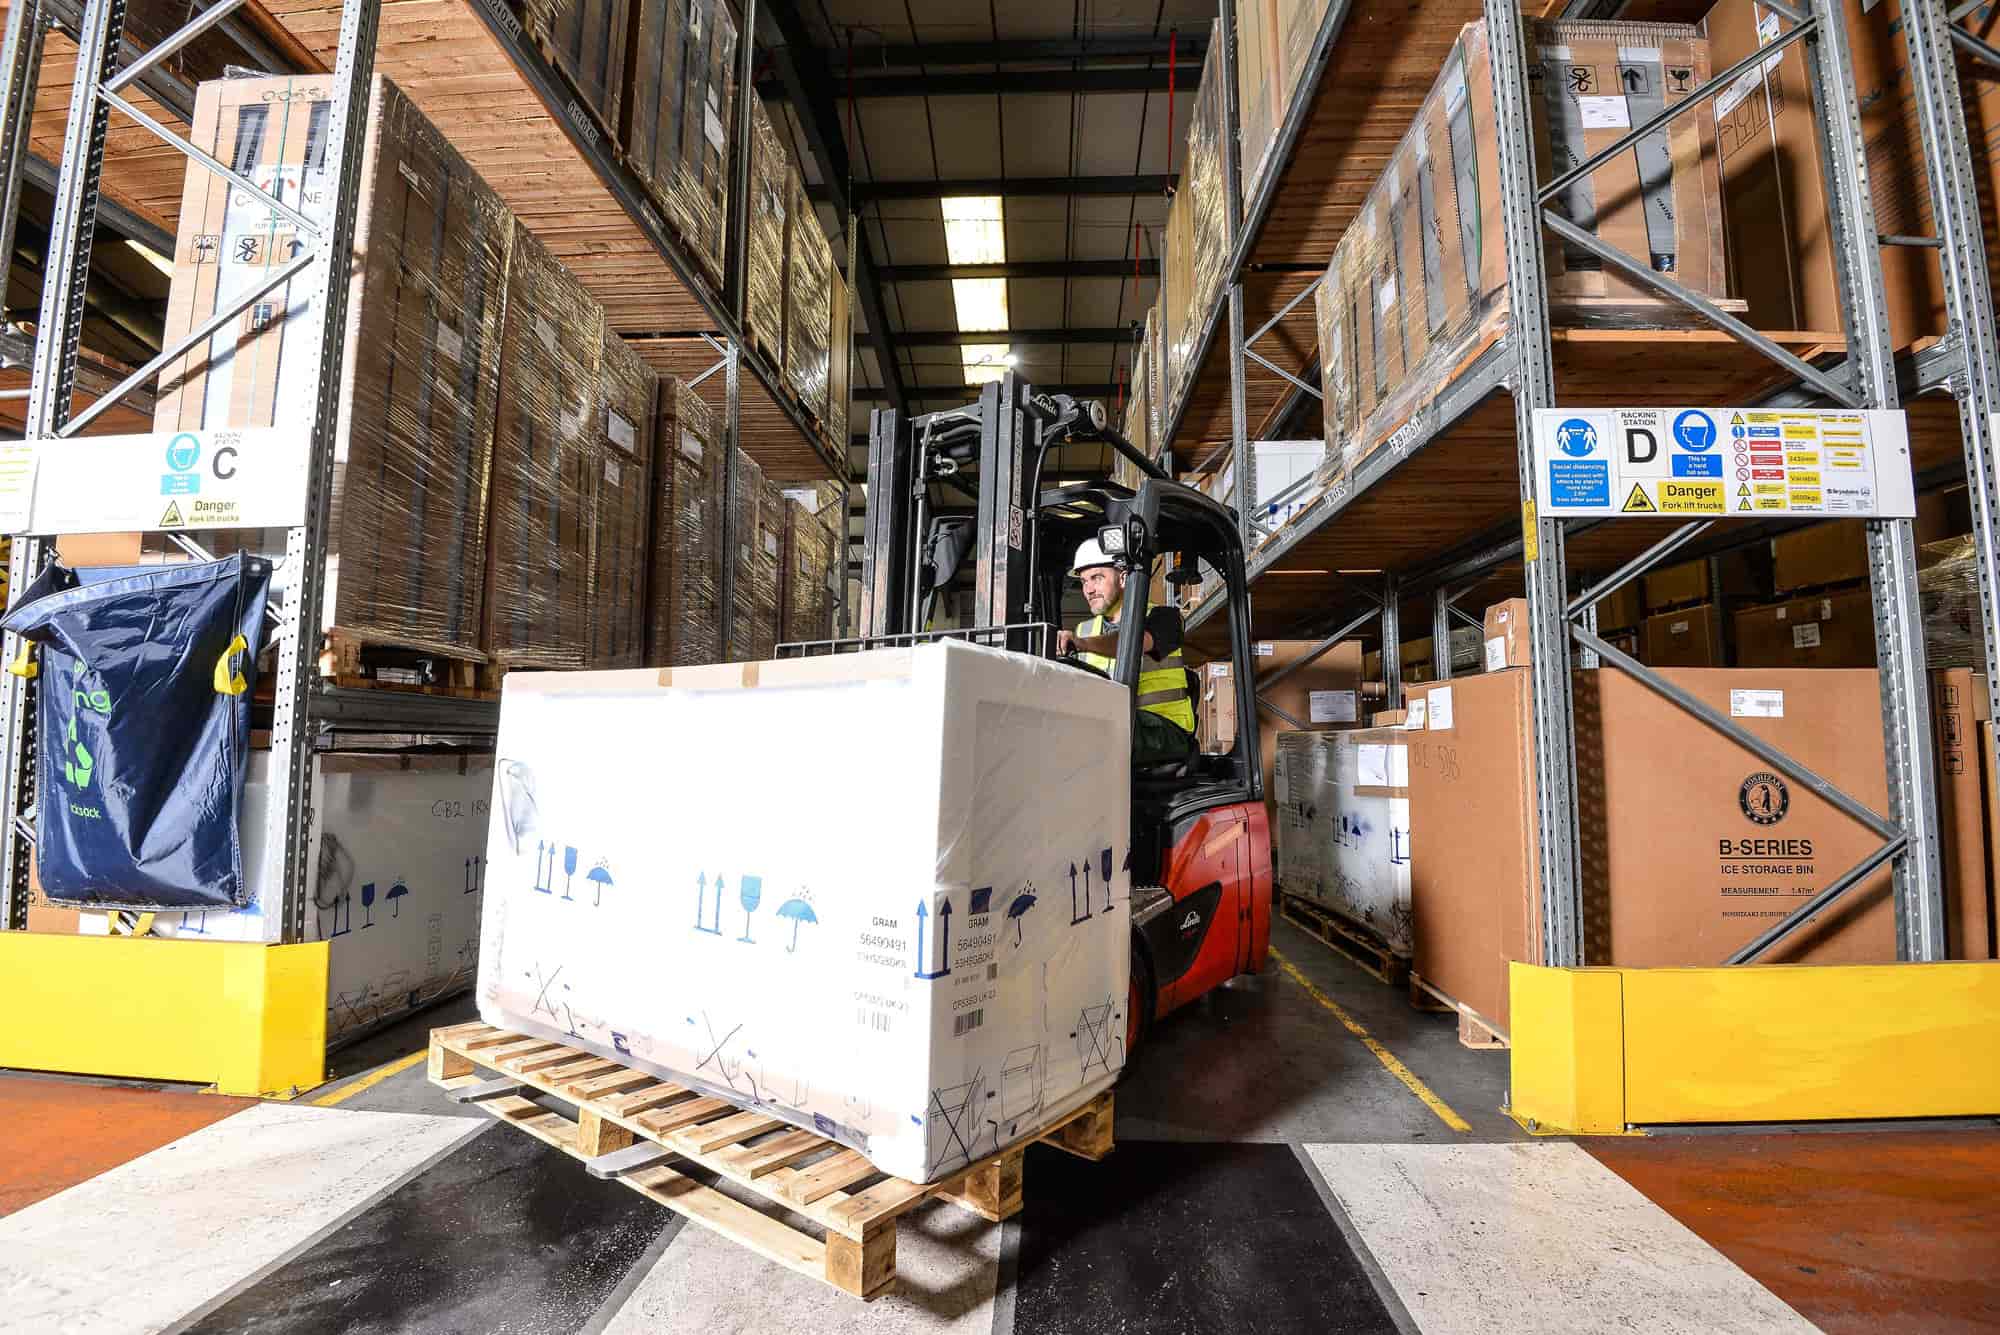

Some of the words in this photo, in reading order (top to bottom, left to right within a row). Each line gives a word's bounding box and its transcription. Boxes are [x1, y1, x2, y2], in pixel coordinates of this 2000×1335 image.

[1621, 411, 1657, 419] RACKING
[1625, 428, 1657, 463] D
[212, 446, 238, 480] C
[1552, 463, 1571, 471] Social
[1572, 463, 1606, 472] distancing
[1667, 485, 1717, 500] Danger
[194, 500, 237, 513] Danger
[1662, 501, 1681, 510] Fork
[1682, 501, 1695, 510] lift
[1696, 501, 1723, 510] trucks
[1719, 839, 1812, 855] B-SERIES
[1720, 865, 1740, 875] ICE
[1741, 865, 1793, 875] STORAGE
[1795, 865, 1815, 875] BIN
[1720, 887, 1780, 895] MEASUREMENT
[872, 915, 898, 929] GRAM
[968, 915, 989, 930] GRAM
